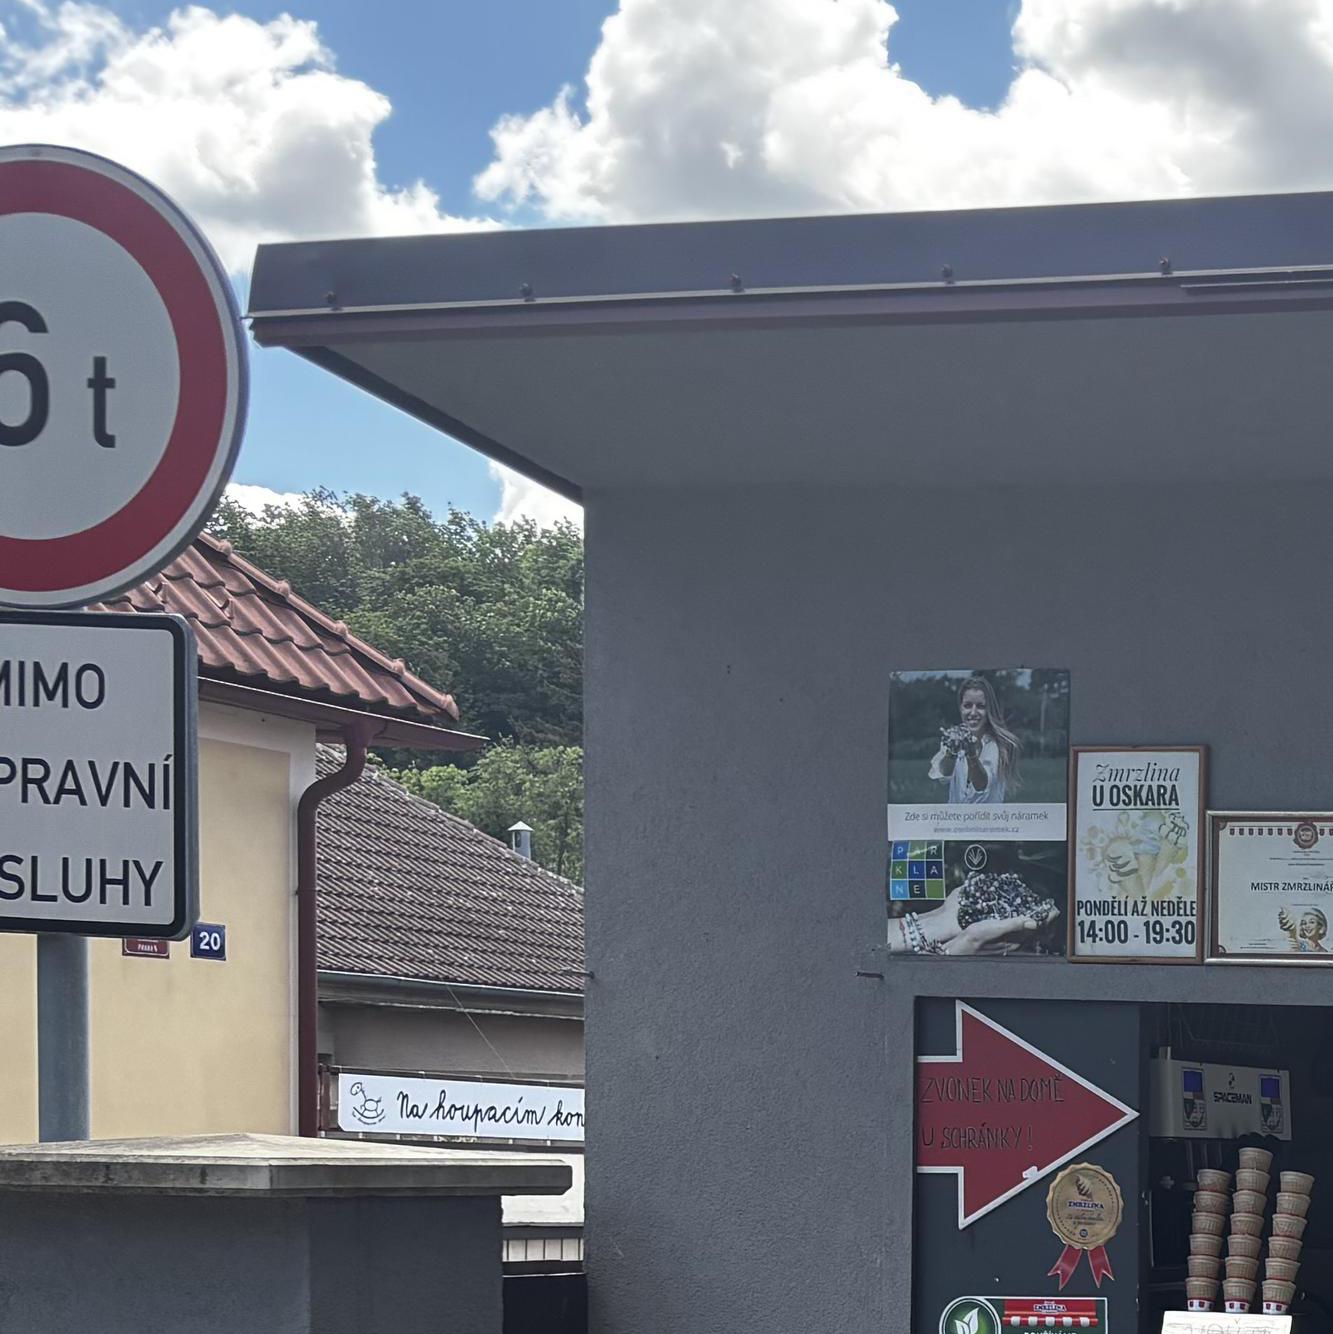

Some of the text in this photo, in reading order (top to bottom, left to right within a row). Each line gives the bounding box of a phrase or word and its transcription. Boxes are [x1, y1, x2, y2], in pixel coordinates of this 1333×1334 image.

[87, 356, 116, 449] t
[1092, 762, 1181, 782] Zmrzlina
[1092, 784, 1179, 806] U OSKARA
[0, 854, 164, 907] SLUHY
[1251, 882, 1279, 891] MISTR
[1077, 895, 1196, 917] PONDĚLÍ AŽ NEDĚLE
[199, 931, 222, 951] 20
[1078, 919, 1129, 943] 14:00
[1143, 920, 1196, 945] 19:30
[920, 1073, 1065, 1104] ZVONEK NA DOMĚ
[397, 1090, 429, 1120] Na
[430, 1089, 547, 1133] houpacím
[922, 1128, 935, 1147] U
